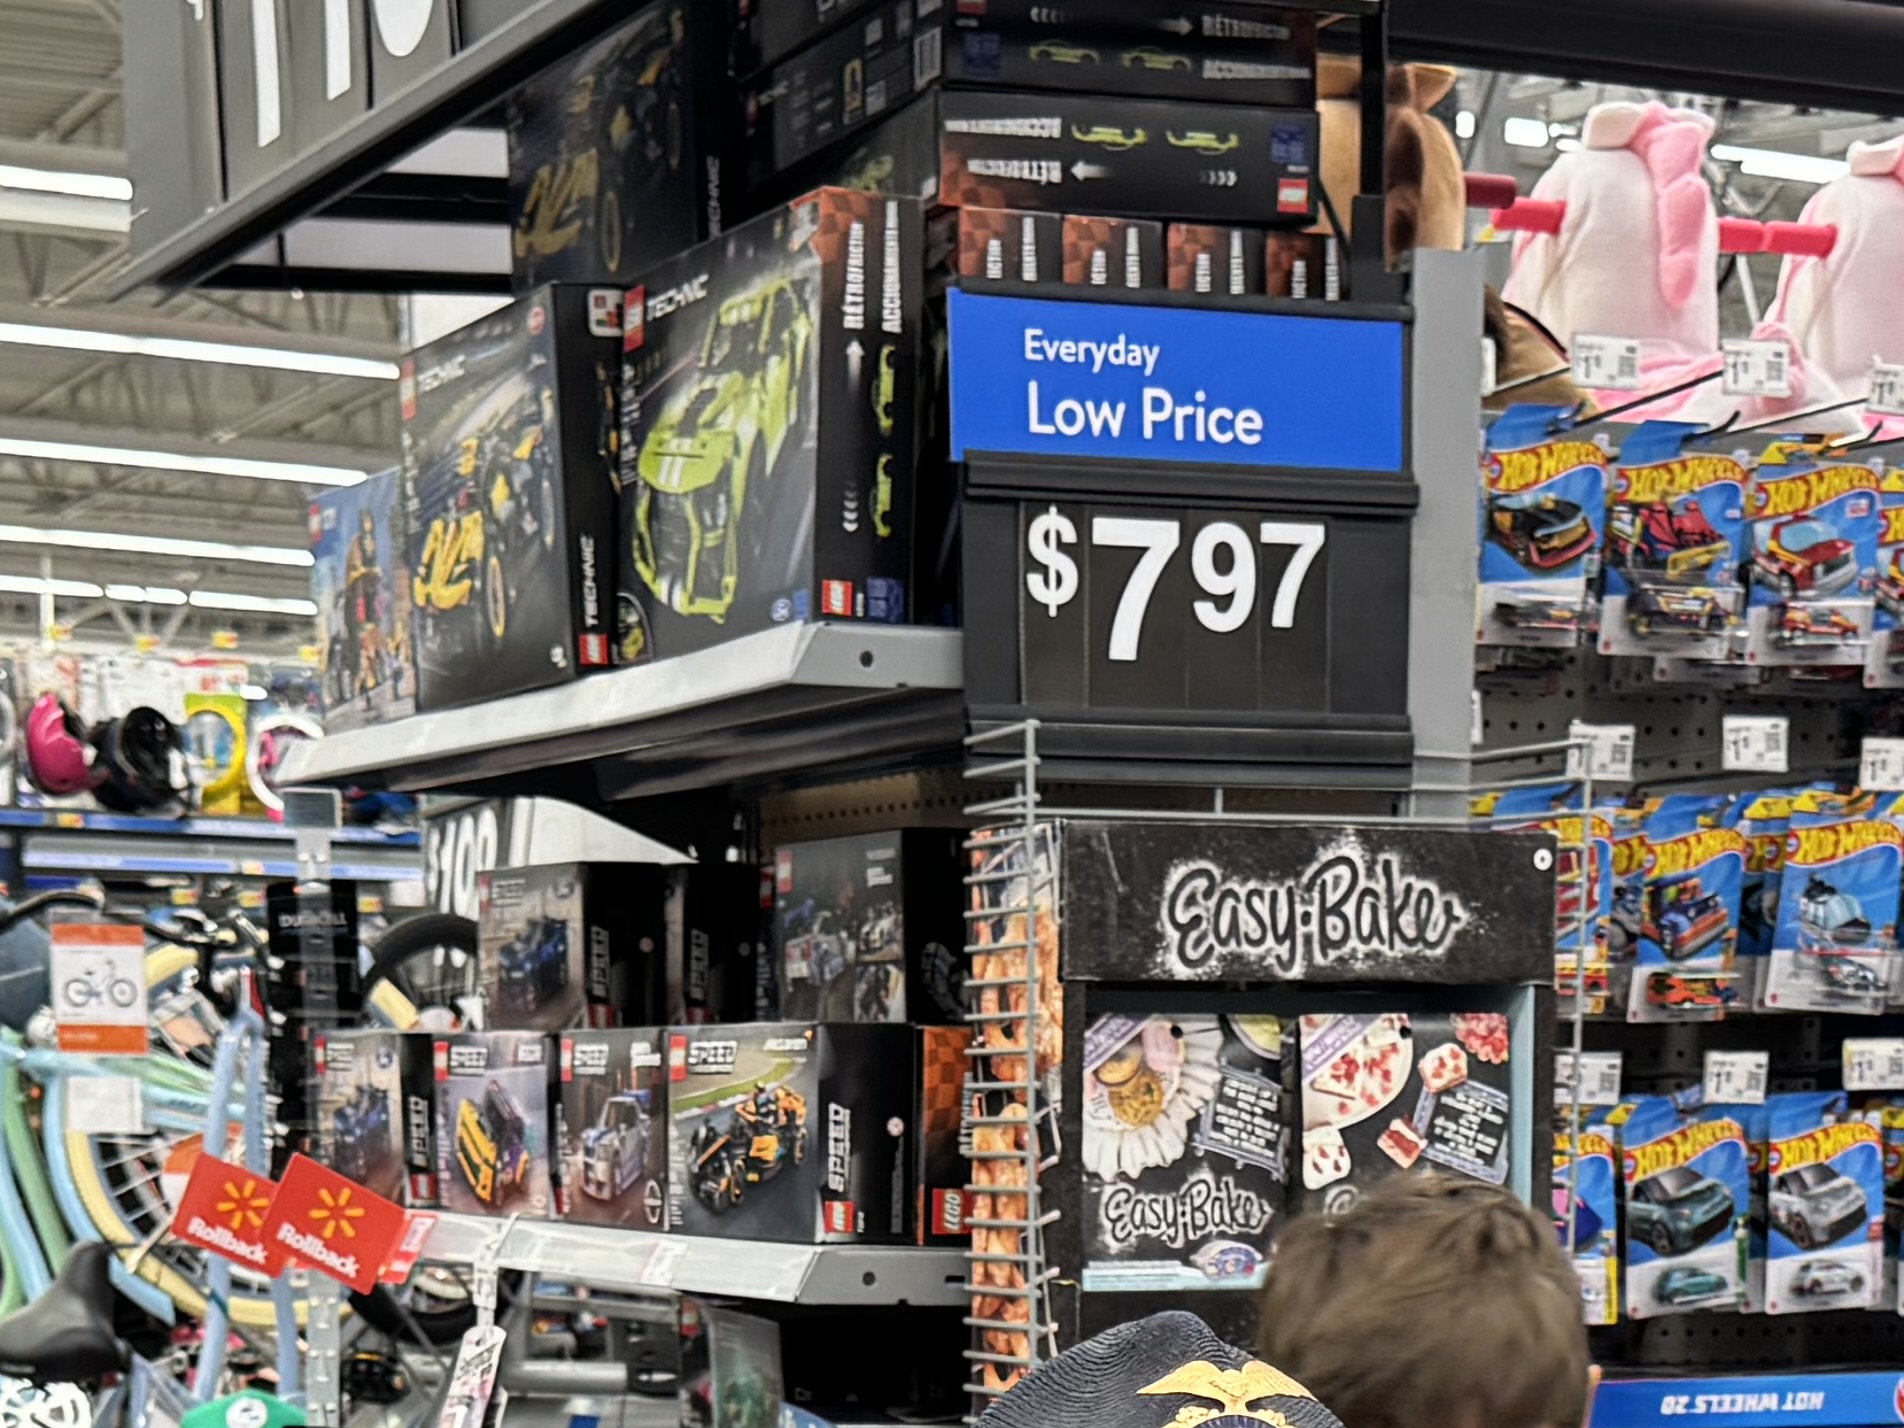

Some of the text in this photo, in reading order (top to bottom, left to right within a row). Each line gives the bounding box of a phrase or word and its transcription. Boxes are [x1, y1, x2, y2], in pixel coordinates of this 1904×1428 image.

[647, 274, 709, 322] TECHNIC
[1025, 328, 1160, 376] Everyday
[1027, 381, 1264, 445] Low Price
[1496, 451, 1537, 489] HOT
[1626, 465, 1665, 500] HOT
[1765, 480, 1805, 516] HOT
[1653, 837, 1690, 874] HOT
[1795, 829, 1834, 864] HOT
[688, 1041, 738, 1064] SPEED
[829, 1102, 846, 1193] SPEED
[1635, 1136, 1678, 1175] HOT
[1780, 1144, 1815, 1176] HOT
[187, 1217, 268, 1264] Rollback
[277, 1223, 360, 1278] Rollback
[1661, 1391, 1825, 1415] HOT WHEELS 20
